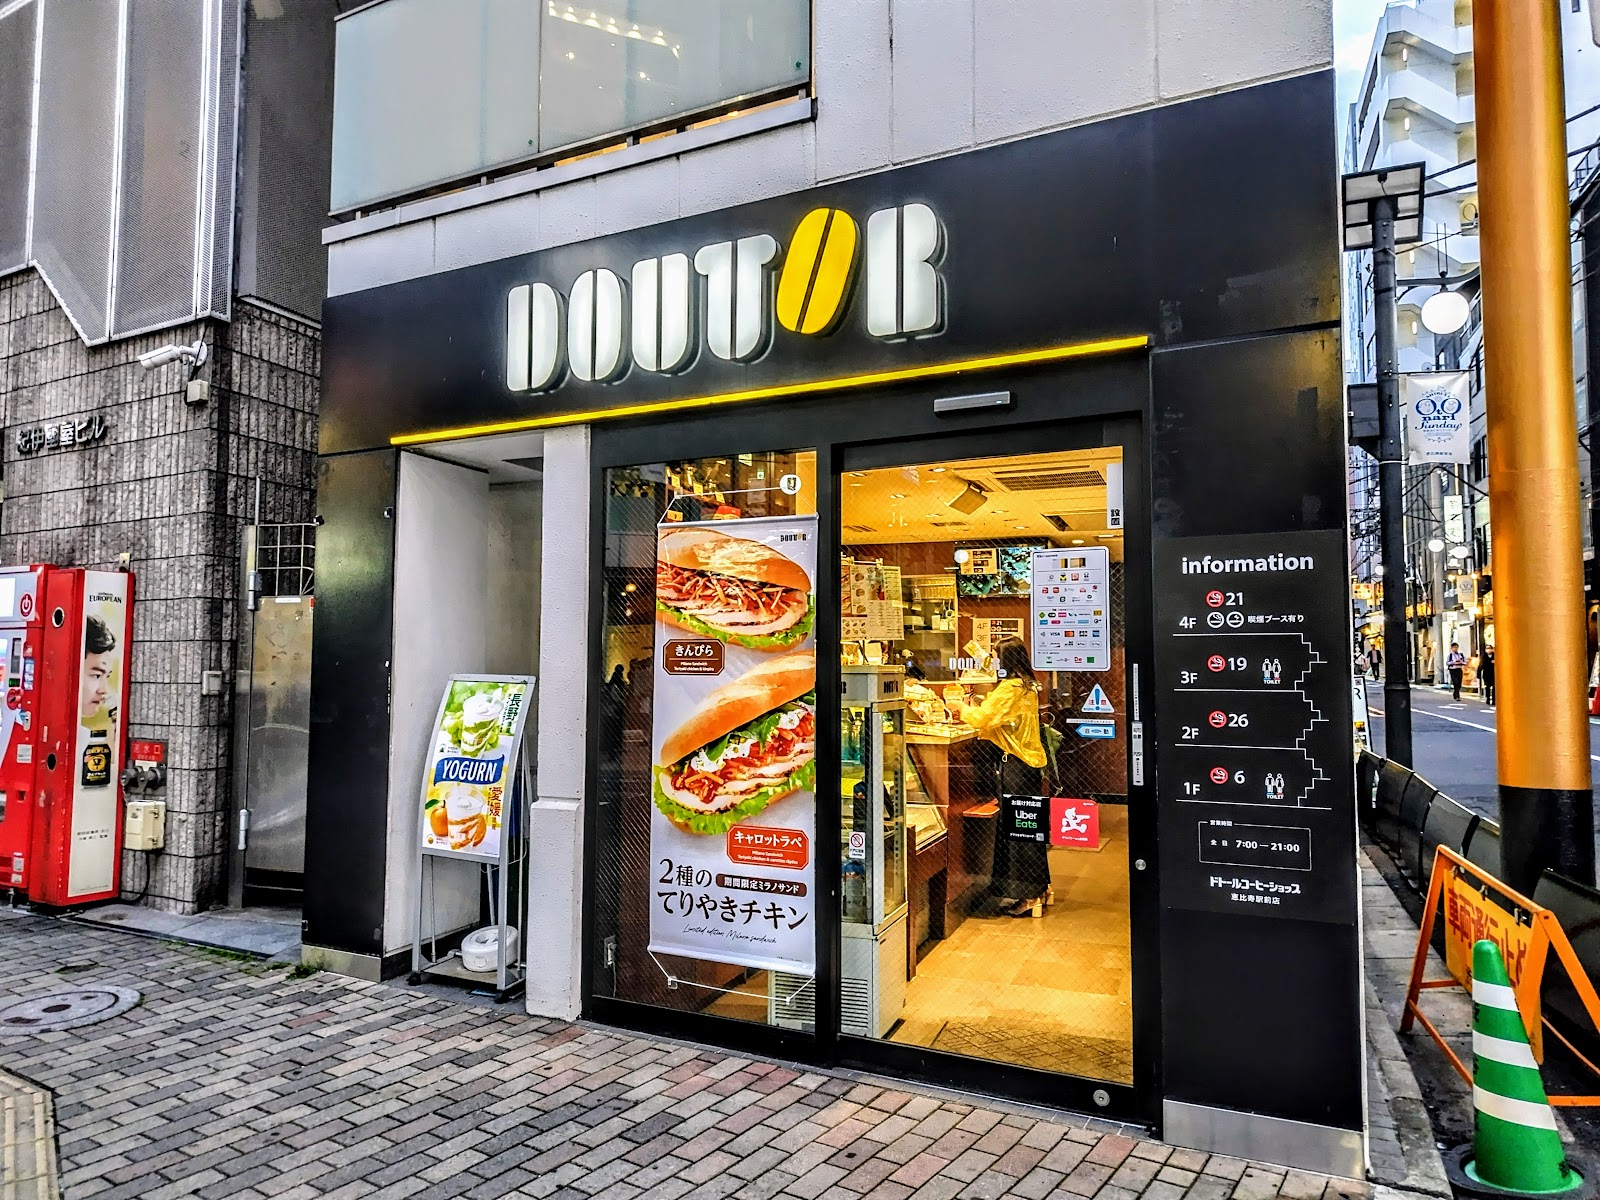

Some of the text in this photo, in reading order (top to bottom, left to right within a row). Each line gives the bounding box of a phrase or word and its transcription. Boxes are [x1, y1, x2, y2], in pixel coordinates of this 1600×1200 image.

[506, 203, 938, 392] DOUTOR
[1414, 421, 1463, 431] Sunday
[1182, 553, 1314, 575] information
[1225, 592, 1244, 606] 21
[1179, 616, 1197, 629] 4F
[675, 644, 714, 657] きんぴら
[1228, 657, 1248, 671] 19
[1180, 671, 1198, 684] 3F
[1228, 713, 1249, 728] 26
[1182, 726, 1199, 740] 2F
[441, 759, 498, 783] YOGURN
[1234, 770, 1246, 784] 6
[1183, 782, 1201, 796] 1F
[1015, 809, 1038, 820] Uber
[1015, 819, 1038, 829] Eats
[734, 831, 803, 848] キャロットラペ
[658, 858, 713, 888] 2種の
[723, 876, 800, 894] 期間限定ミラノサンド
[657, 890, 809, 931] てりやきチキン
